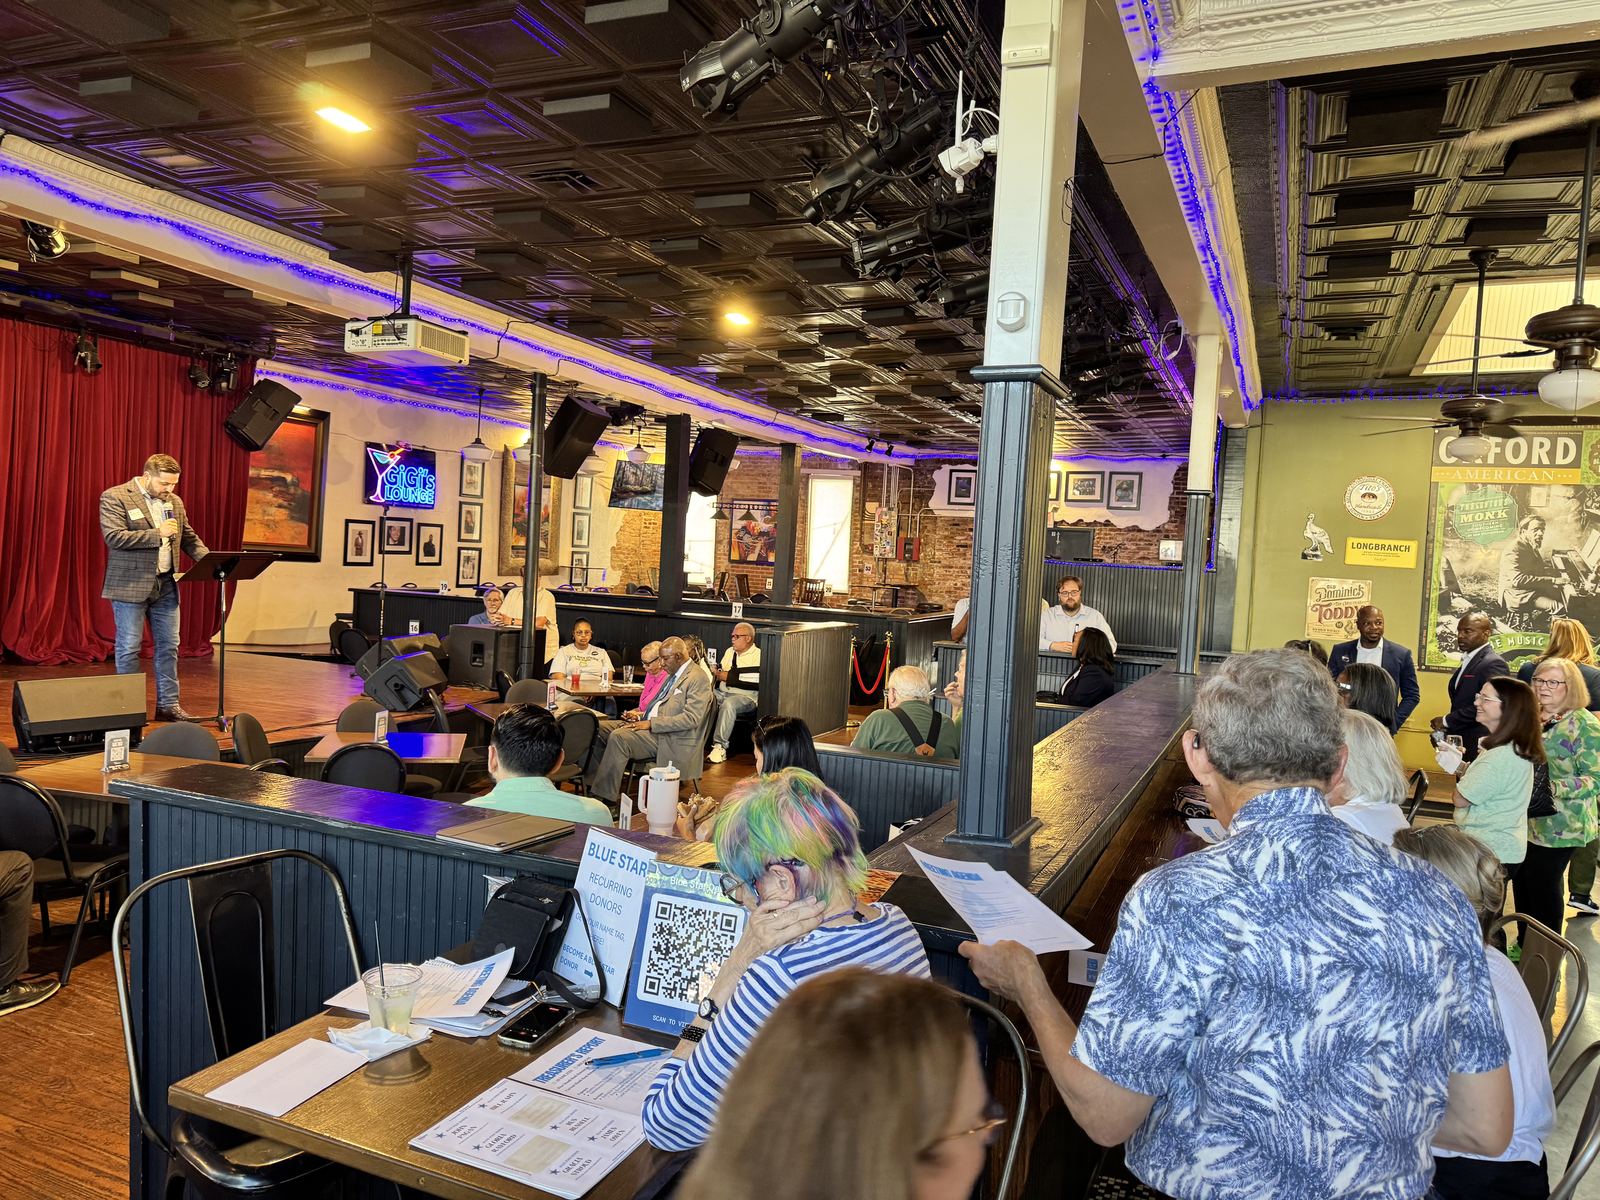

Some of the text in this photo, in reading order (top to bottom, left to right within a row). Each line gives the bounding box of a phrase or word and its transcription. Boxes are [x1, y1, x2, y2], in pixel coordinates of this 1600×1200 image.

[1438, 436, 1577, 464] OFORD
[1449, 468, 1555, 482] AMERICAN
[384, 486, 434, 504] LOUNGE
[1460, 509, 1510, 523] MONK
[1351, 542, 1411, 552] LONGBRANCH
[734, 606, 741, 614] 17
[1508, 636, 1545, 648] MUSIC
[588, 842, 617, 866] BLUE
[618, 854, 648, 878] STAR
[589, 872, 633, 898] RECURRING
[670, 877, 688, 887] Blue
[590, 893, 622, 916] DONORS
[562, 944, 584, 960] BECOME
[560, 956, 579, 971] DONOR
[652, 1014, 666, 1024] SCAN
[532, 1052, 584, 1084] TREASURER'S
[575, 1036, 606, 1055] REPORT
